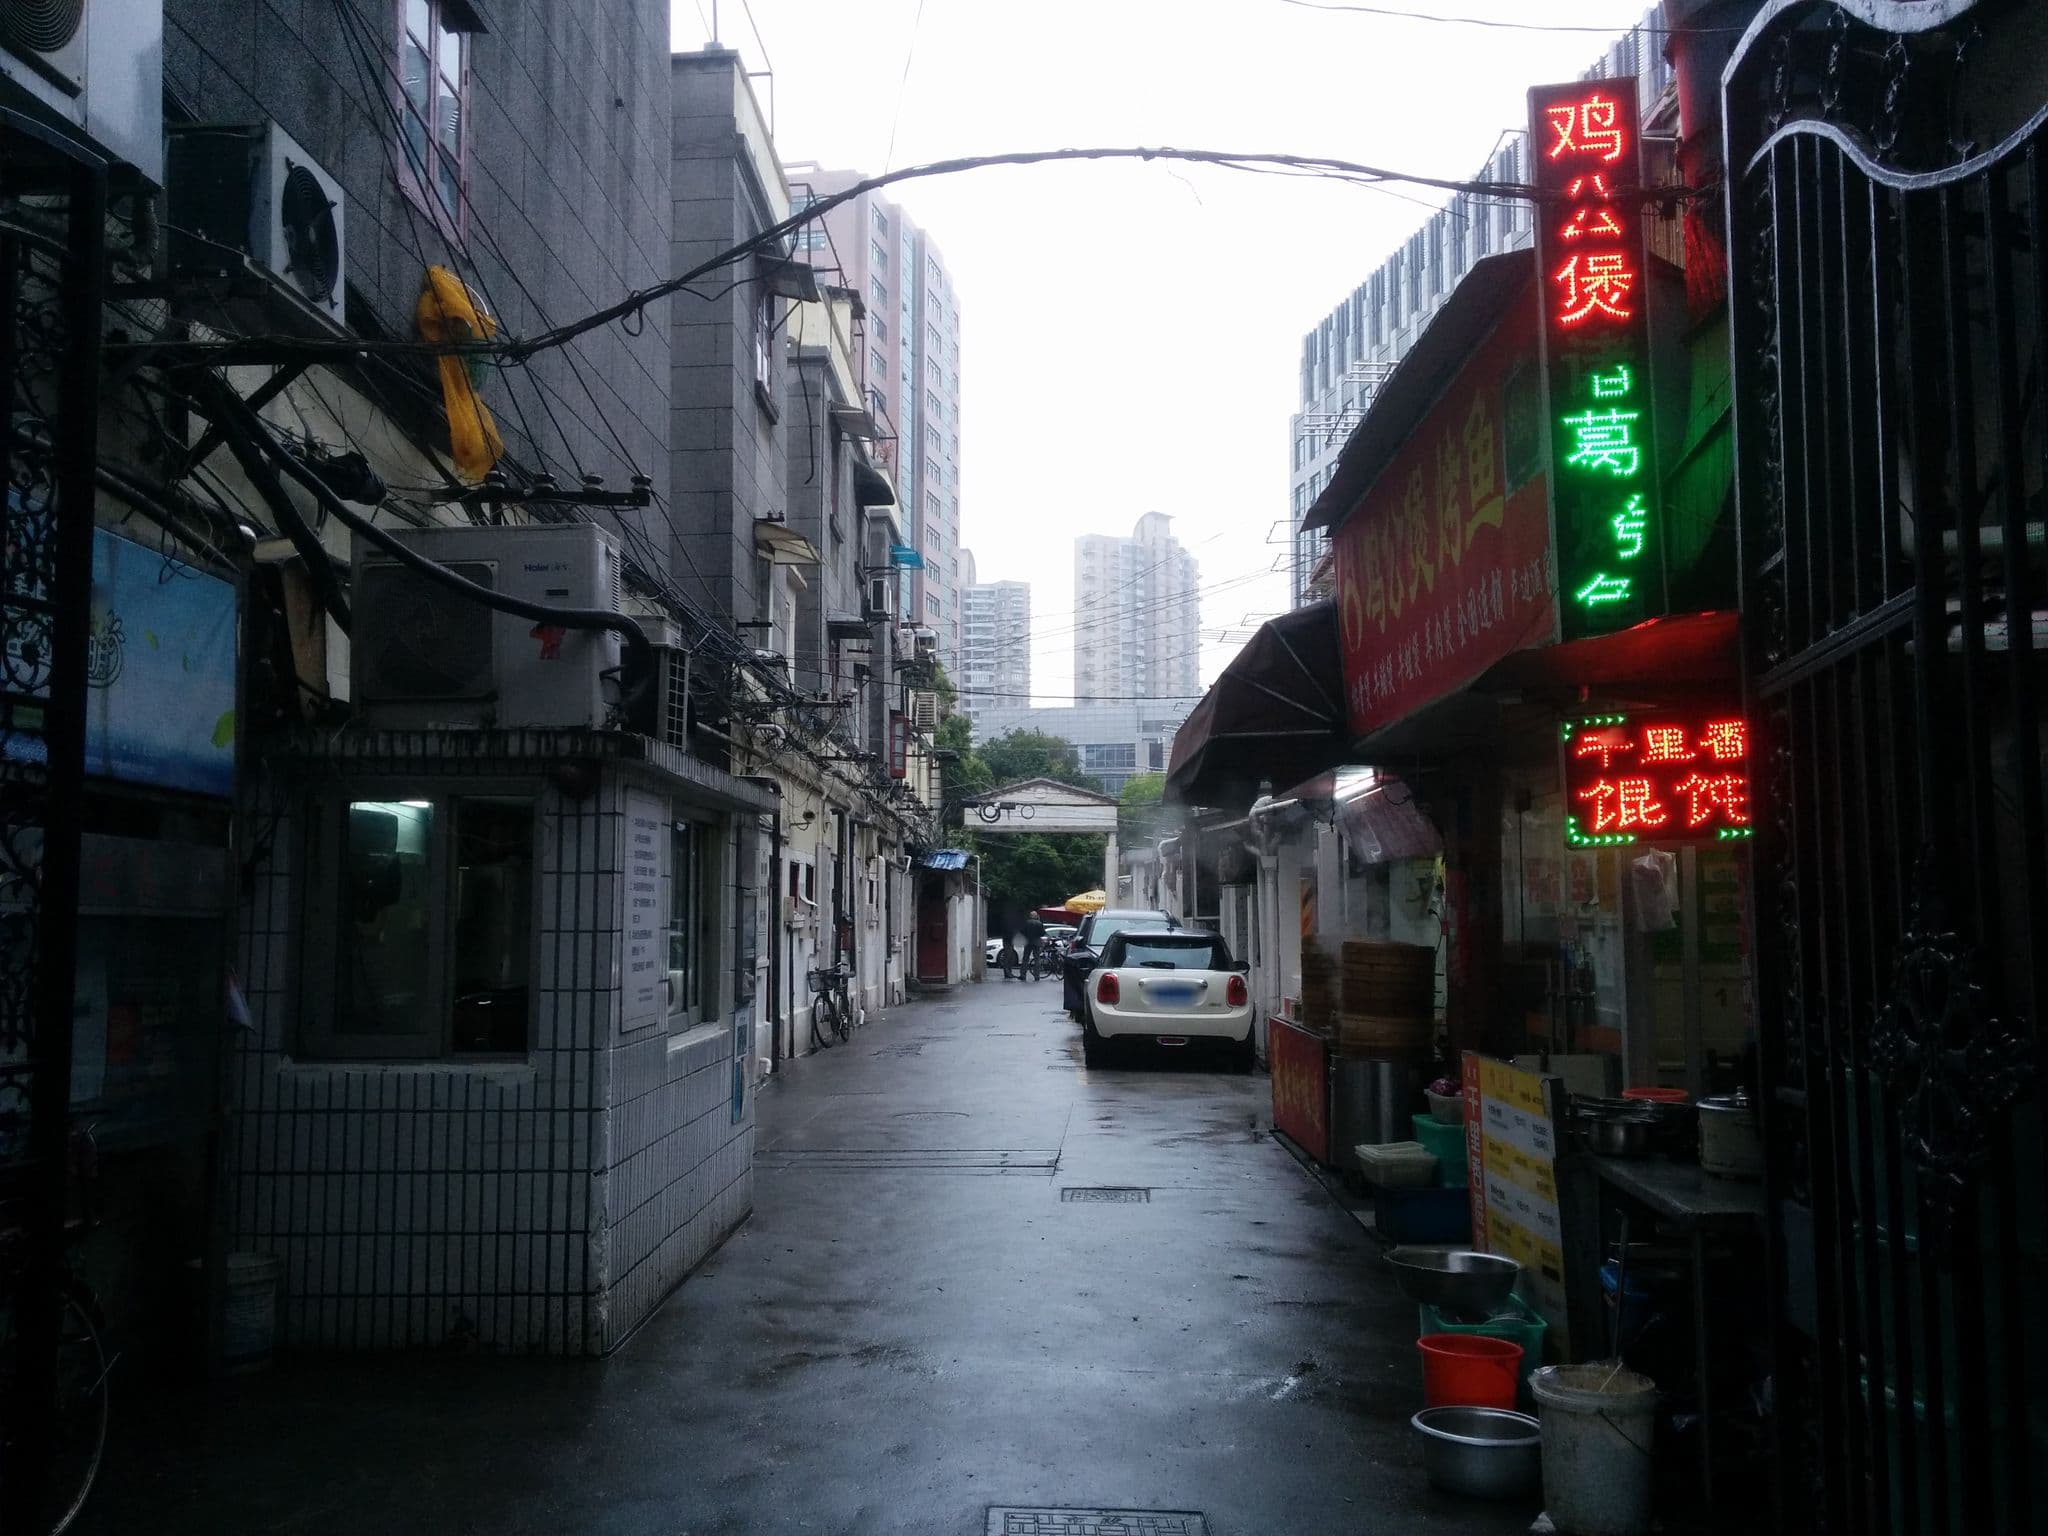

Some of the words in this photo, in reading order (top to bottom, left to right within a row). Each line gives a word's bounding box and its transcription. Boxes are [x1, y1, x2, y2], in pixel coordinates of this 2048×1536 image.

[1545, 95, 1633, 328] 鸡公煲
[1579, 773, 1749, 831] 馄饨
